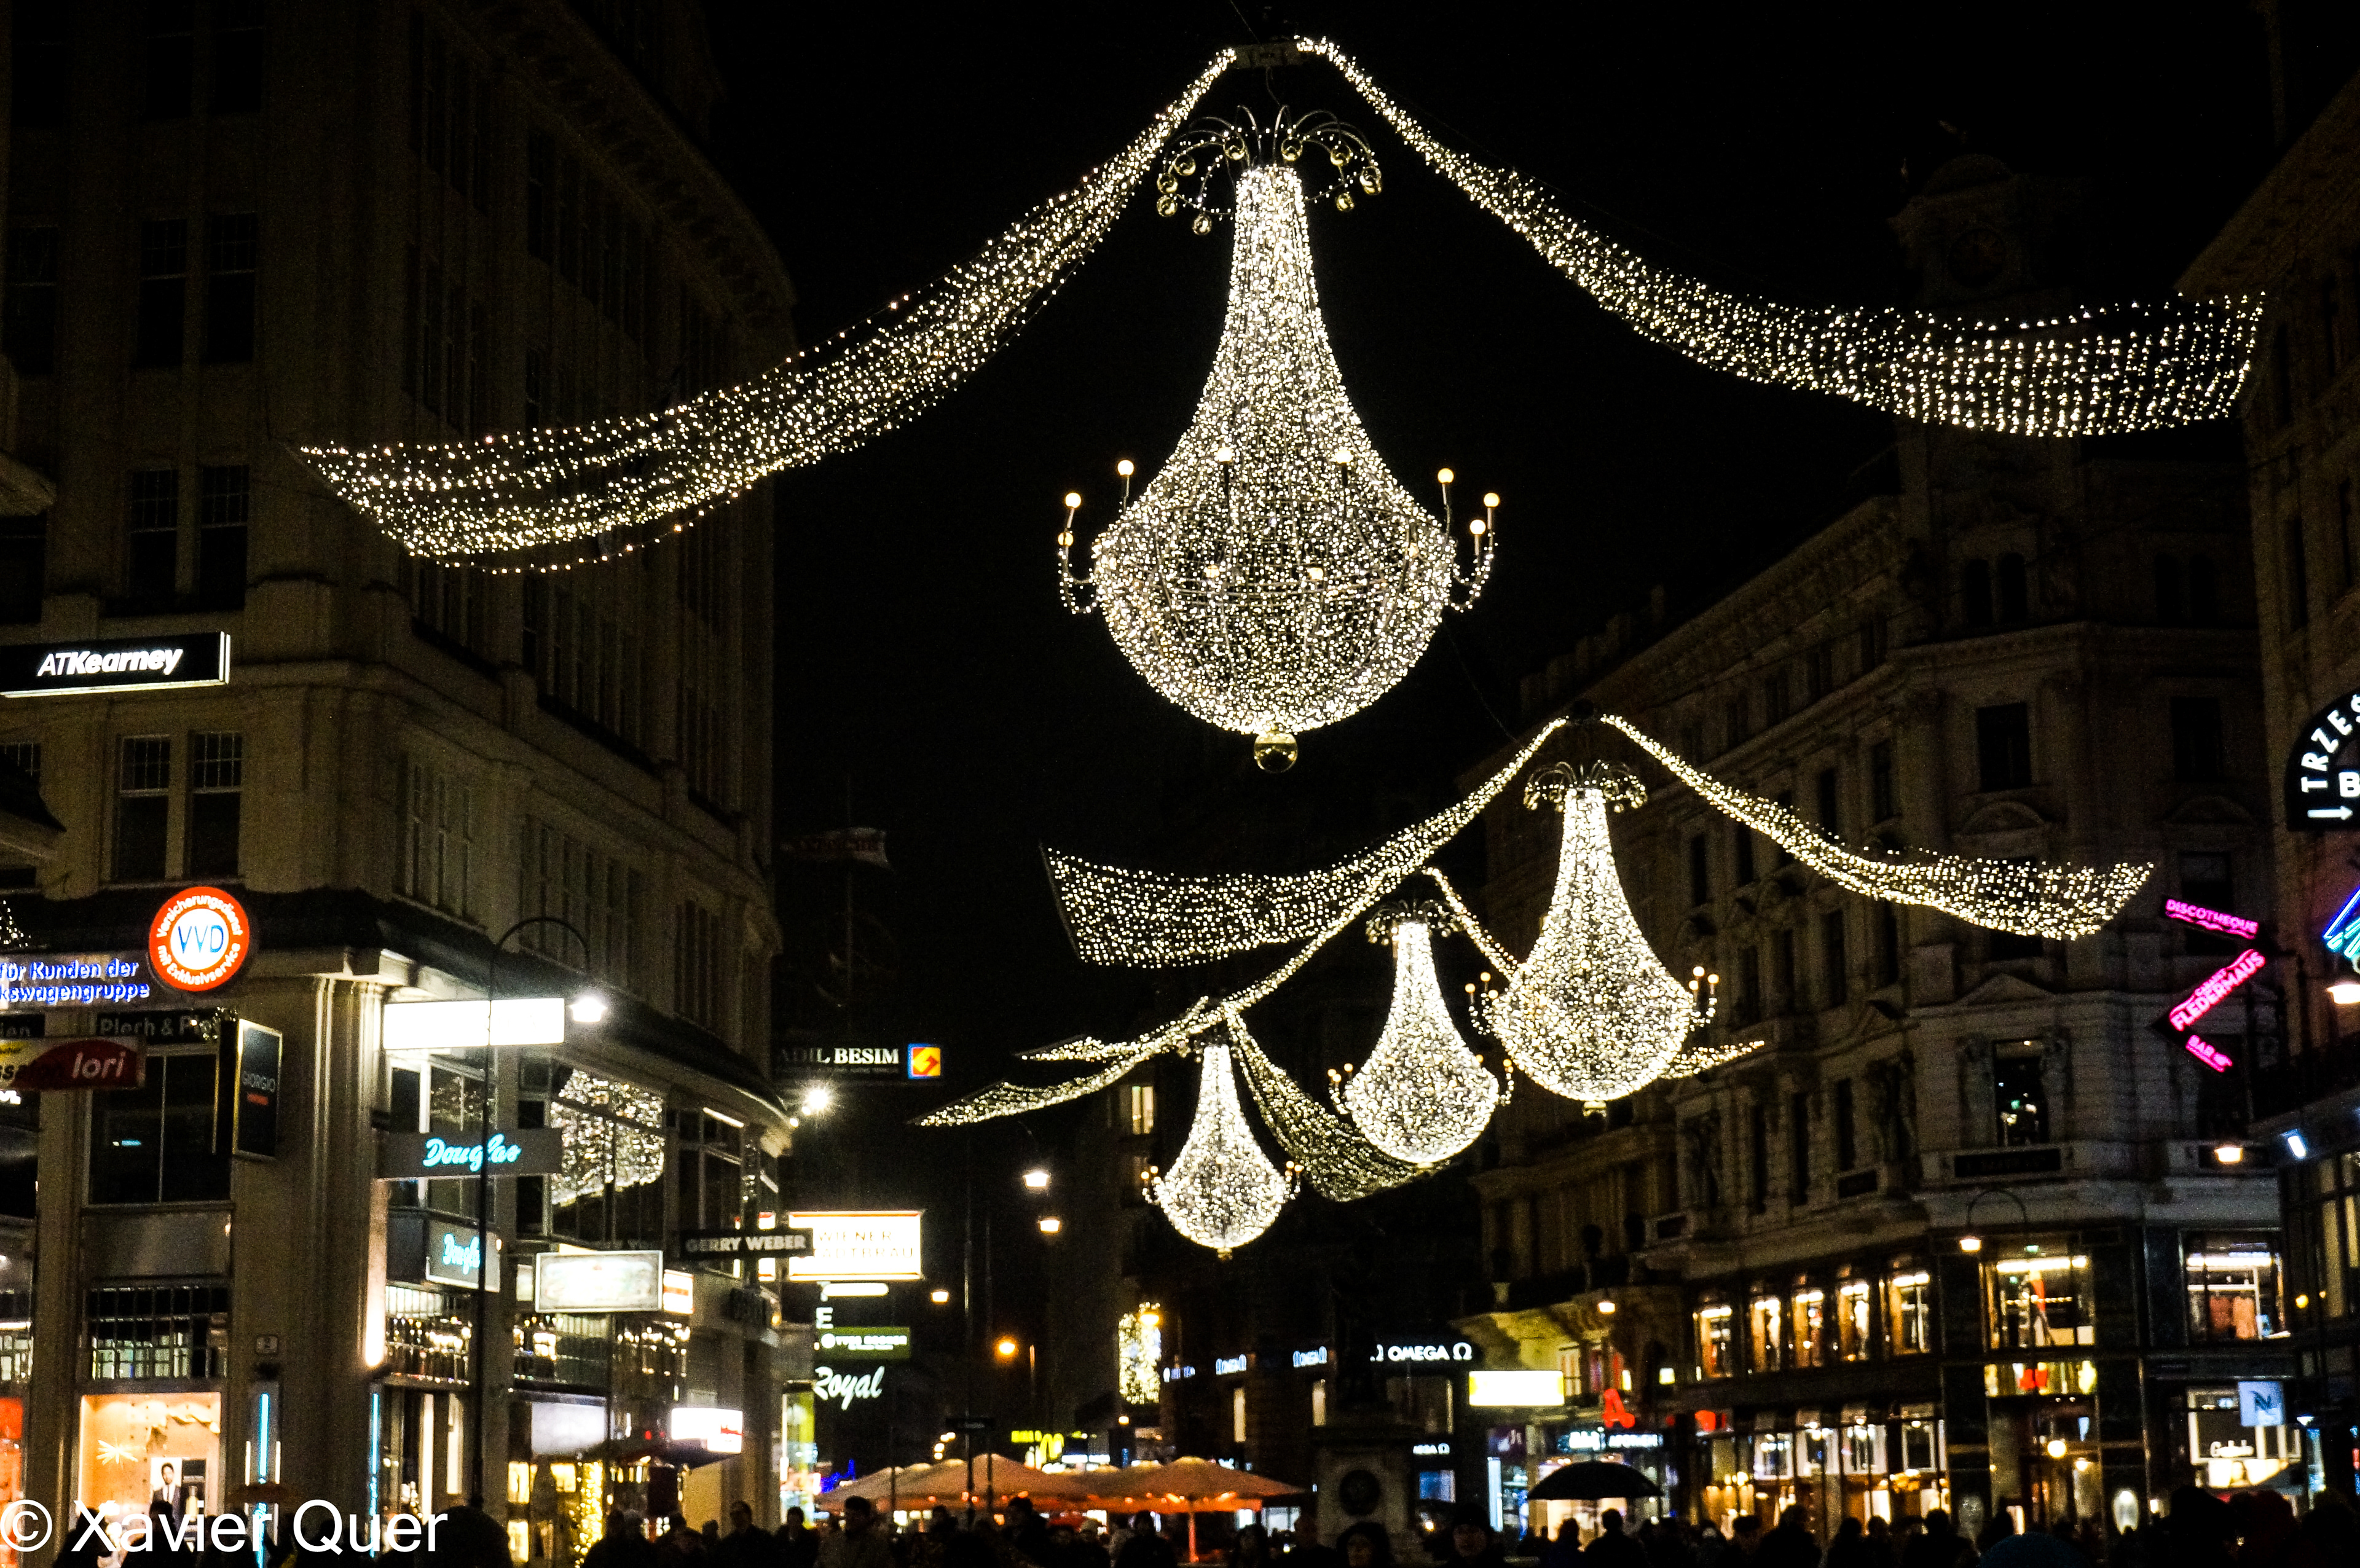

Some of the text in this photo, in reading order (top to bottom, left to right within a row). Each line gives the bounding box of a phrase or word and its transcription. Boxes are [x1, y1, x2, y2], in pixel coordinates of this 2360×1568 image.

[36, 649, 183, 676] ATKearney
[156, 895, 243, 938] Versicherungsdienst
[2165, 899, 2259, 934] DISCOTHEQUE
[178, 925, 224, 954] VVD
[31, 960, 102, 980] Kunden
[106, 958, 139, 978] der
[157, 945, 172, 966] mit
[167, 943, 241, 986] Exklusivservice
[2170, 952, 2265, 1032] FLEDERMAUS
[834, 1048, 899, 1064] BESIM
[423, 1133, 521, 1172] Douglas
[746, 1235, 806, 1250] WEBER
[819, 1231, 892, 1242] WIENER
[1388, 1345, 1450, 1361] OMEGA
[813, 1365, 885, 1411] Royal
